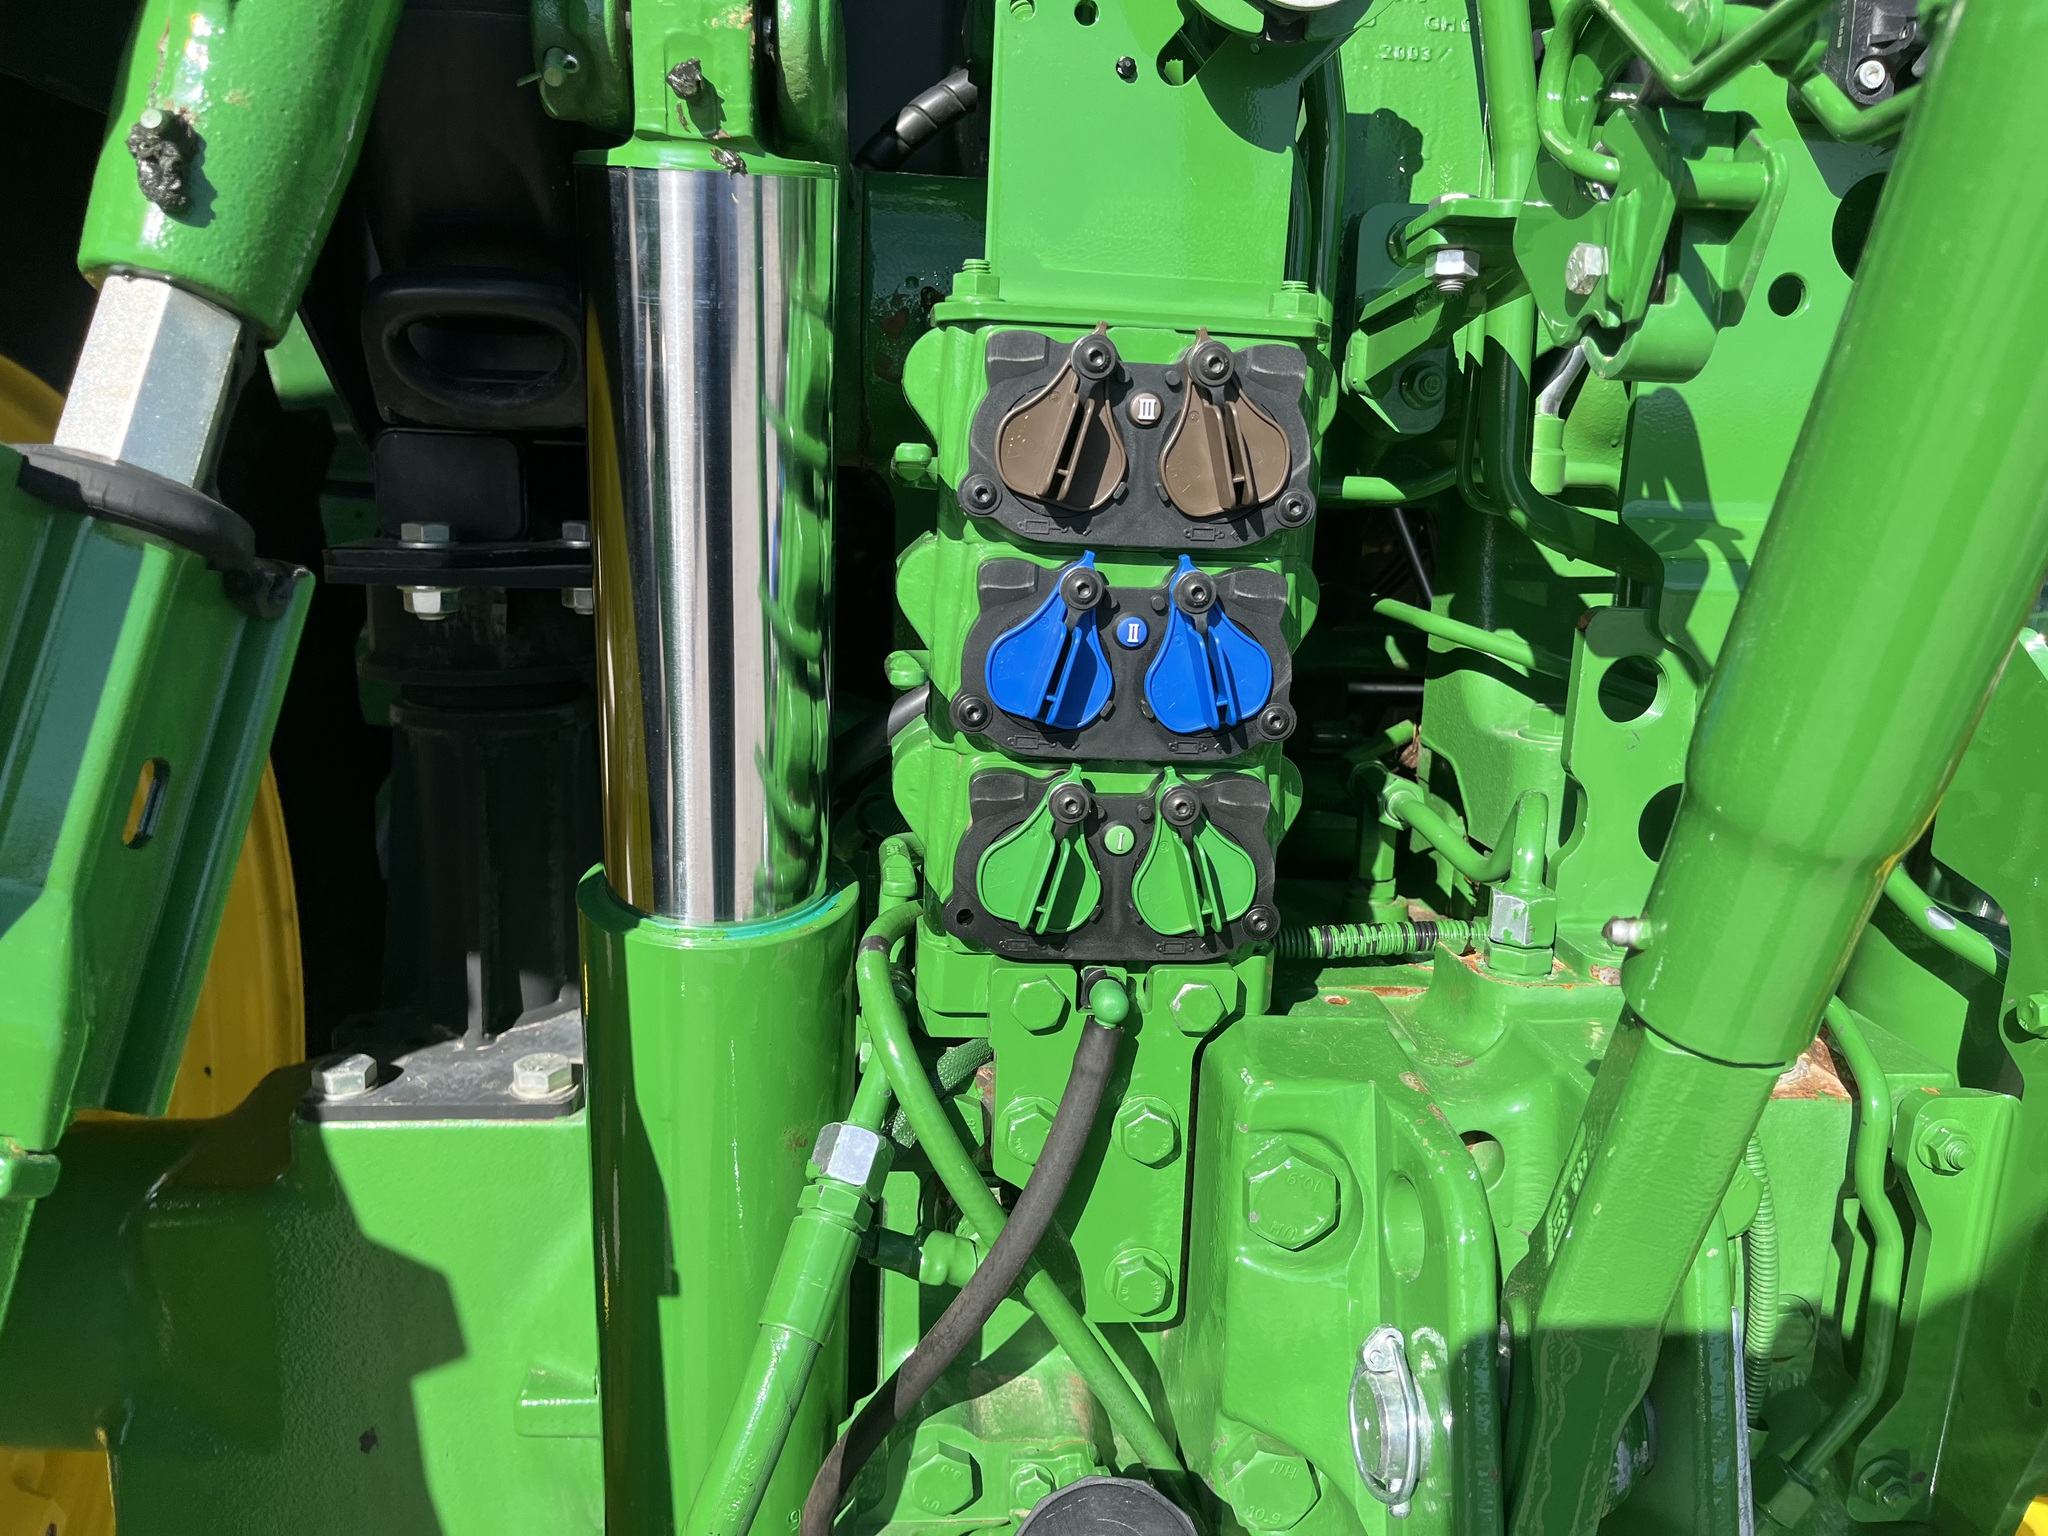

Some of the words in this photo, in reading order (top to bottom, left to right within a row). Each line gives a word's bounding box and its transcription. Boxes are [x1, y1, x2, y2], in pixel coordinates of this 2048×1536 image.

[1138, 399, 1157, 420] III
[1127, 623, 1139, 643] II
[1116, 832, 1124, 851] I
[1286, 1172, 1320, 1193] 10.9
[1244, 1505, 1281, 1524] 10.9
